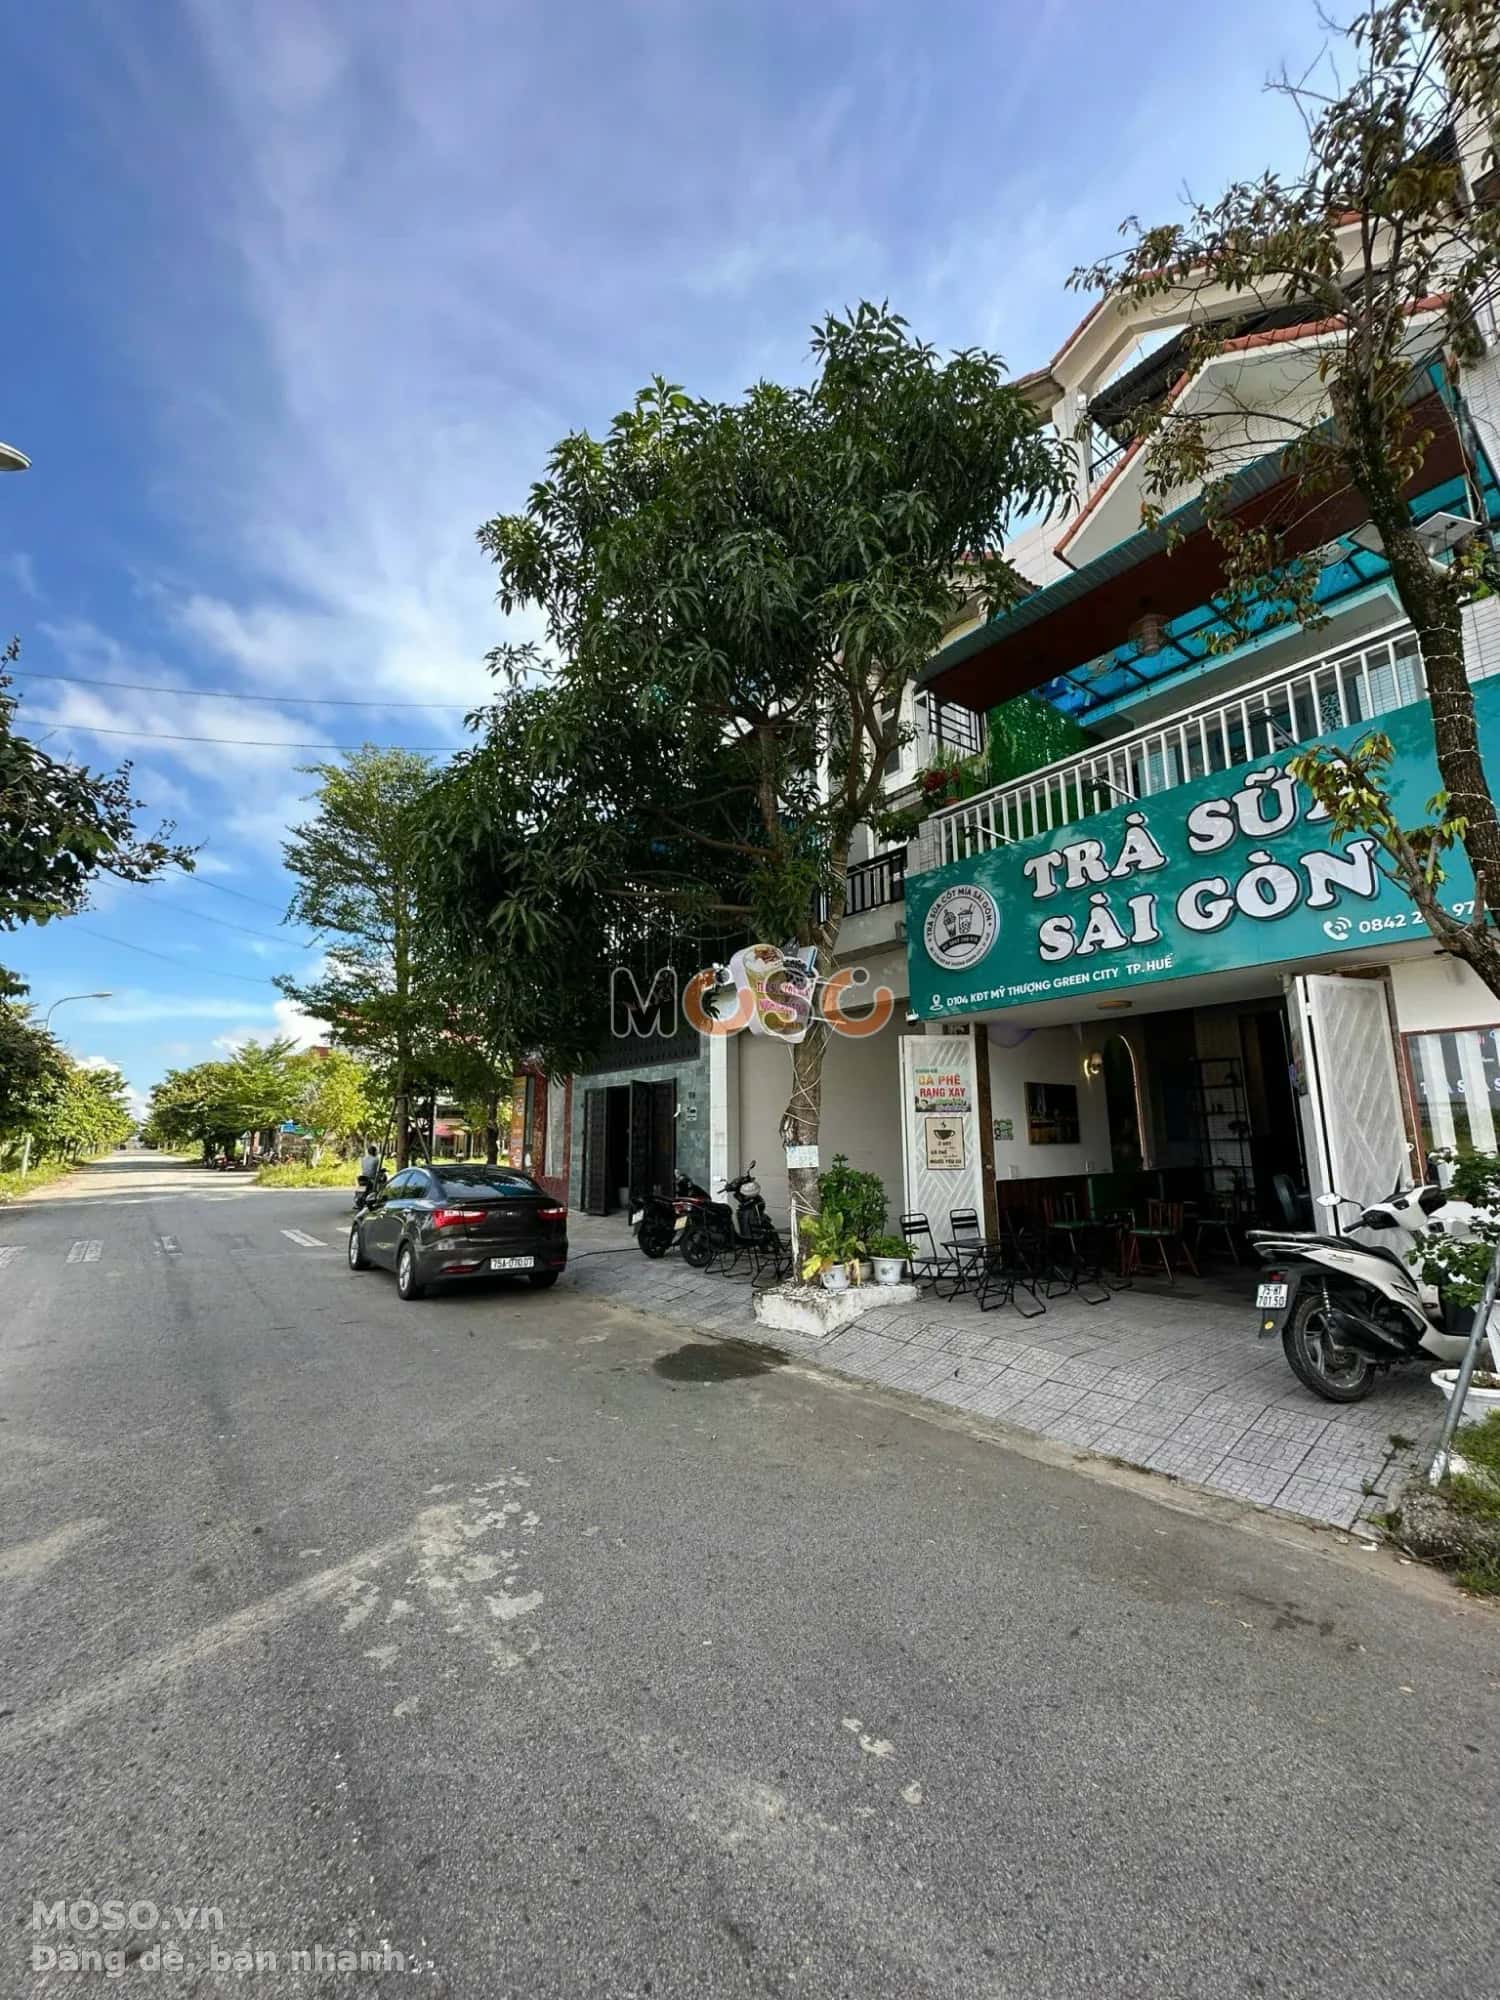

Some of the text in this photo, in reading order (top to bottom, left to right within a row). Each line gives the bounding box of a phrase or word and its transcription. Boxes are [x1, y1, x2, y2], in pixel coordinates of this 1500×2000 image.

[1023, 811, 1168, 898] TRÀ
[1039, 891, 1161, 961] SÀI
[1176, 838, 1378, 931] GÒN
[1358, 914, 1407, 933] 0842
[1007, 980, 1052, 996] THƯỢNG
[1053, 972, 1090, 988] GREEN
[1092, 967, 1119, 981] CITY
[920, 1087, 966, 1097] RANG XAY
